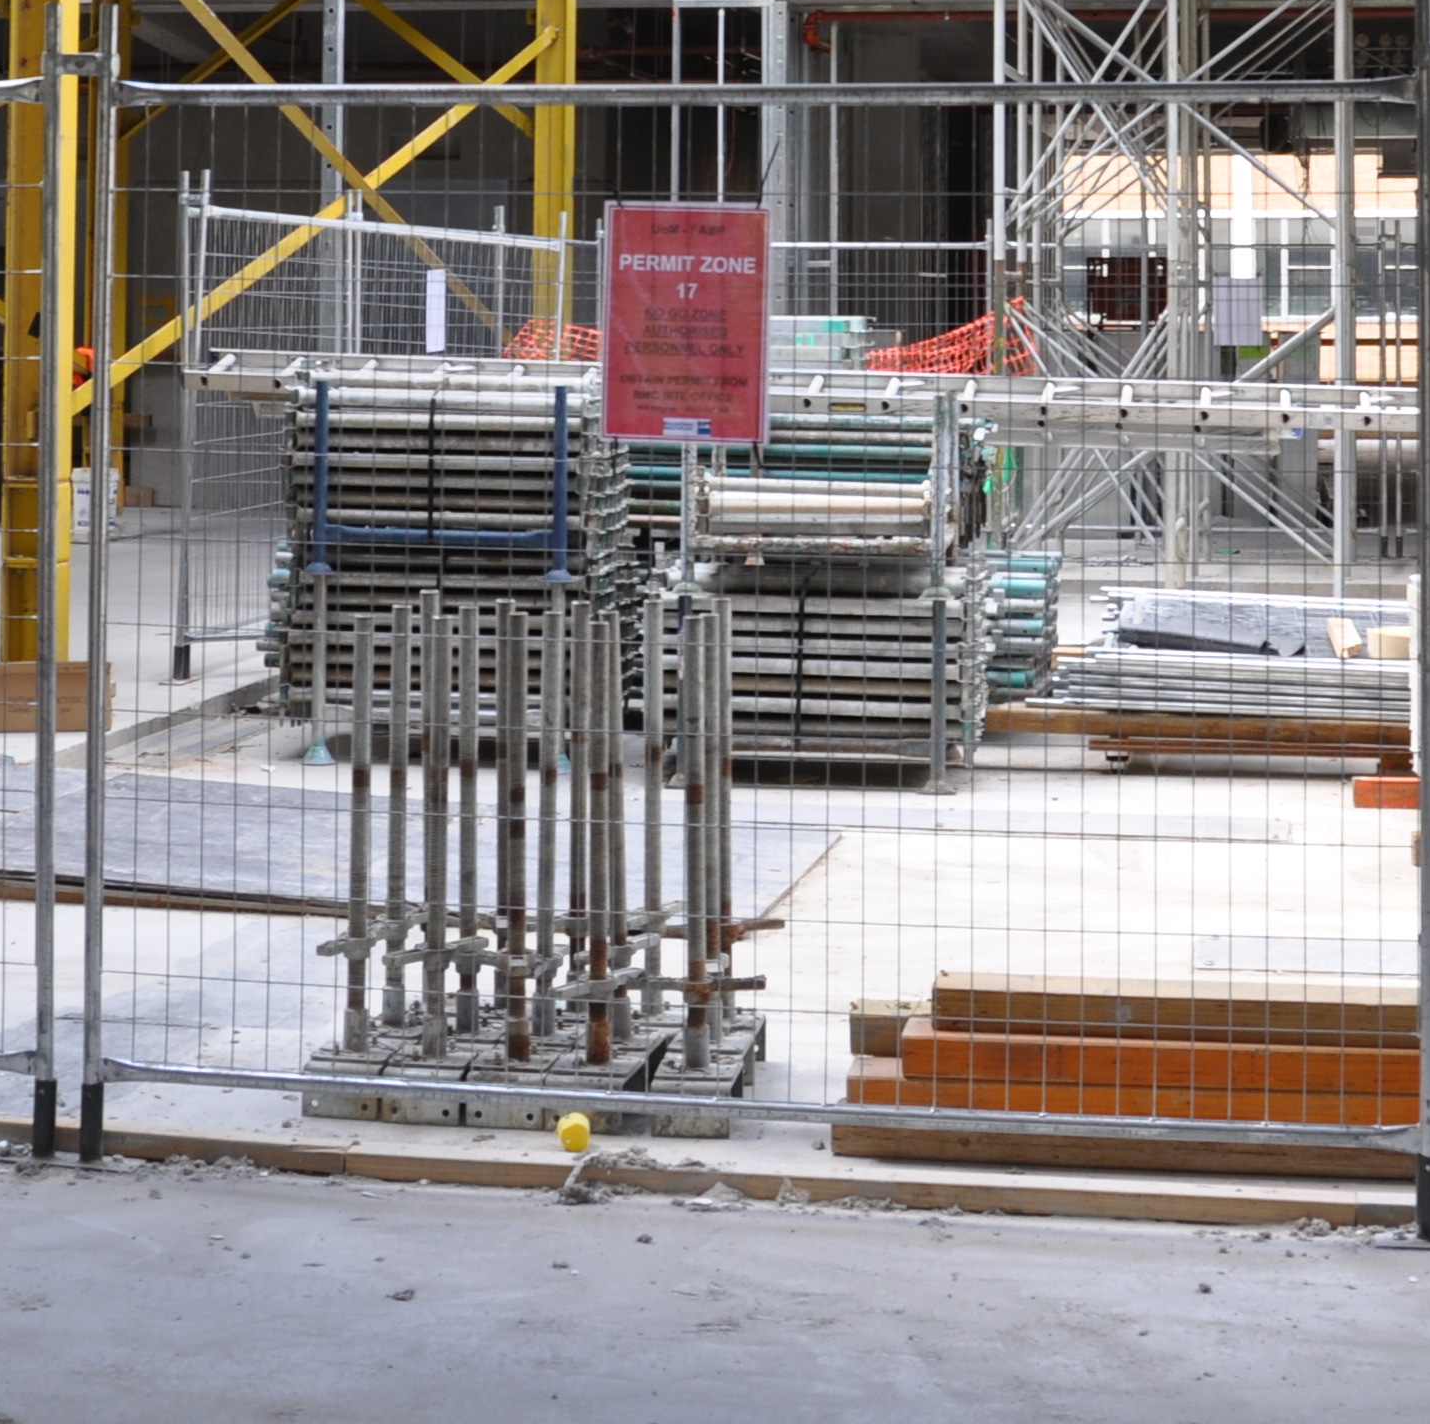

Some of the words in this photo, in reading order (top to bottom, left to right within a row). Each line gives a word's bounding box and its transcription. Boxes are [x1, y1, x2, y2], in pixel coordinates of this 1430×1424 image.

[619, 253, 695, 272] PERMIT
[699, 256, 757, 274] ZONE
[676, 282, 698, 299] 17
[645, 308, 664, 320] NO
[667, 308, 689, 321] GO
[692, 309, 726, 322] ZONE
[625, 341, 706, 356] PERSONNEL
[709, 344, 744, 357] ONLY
